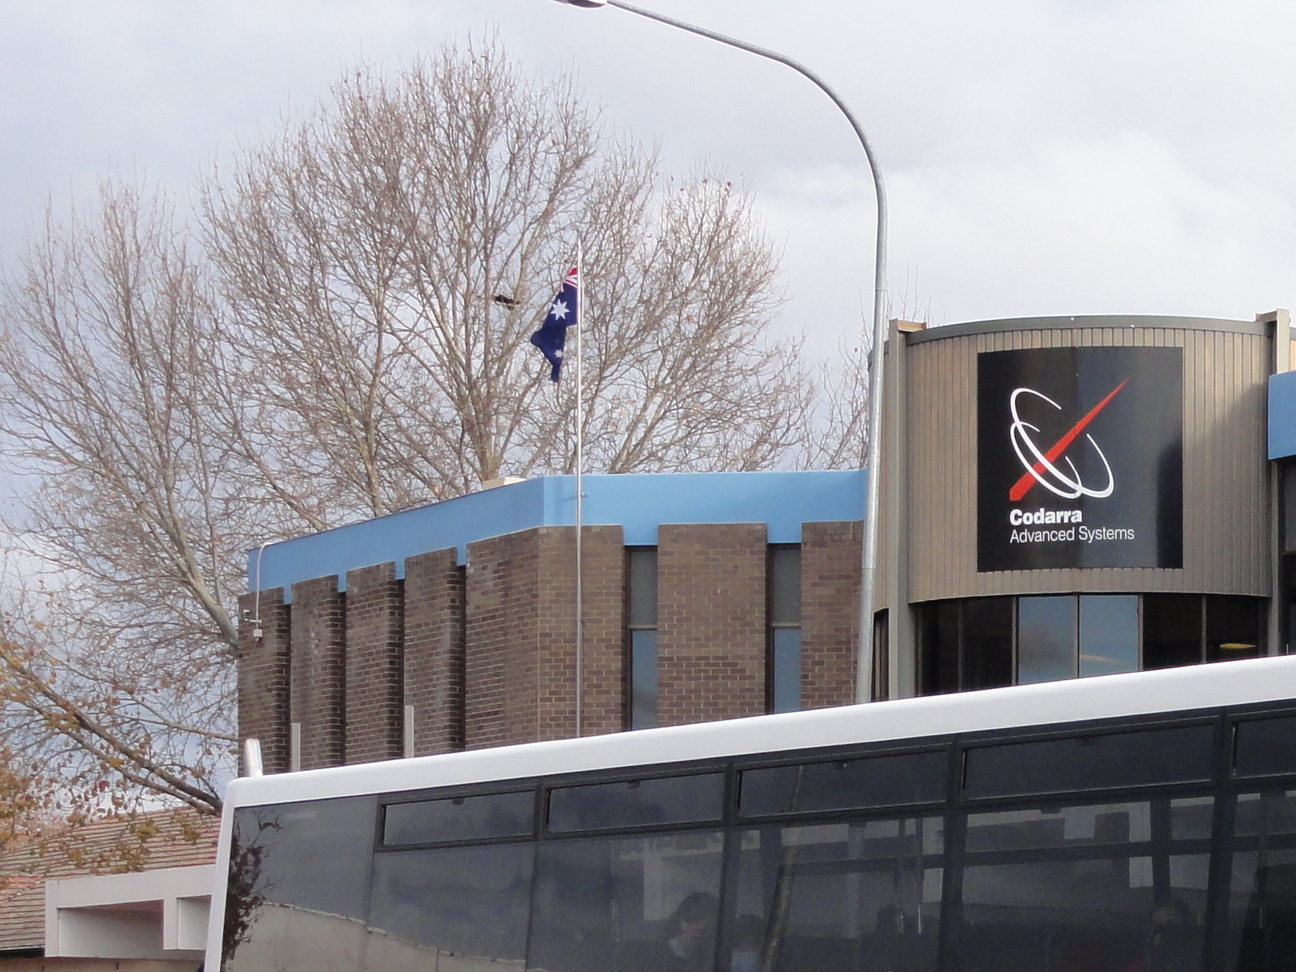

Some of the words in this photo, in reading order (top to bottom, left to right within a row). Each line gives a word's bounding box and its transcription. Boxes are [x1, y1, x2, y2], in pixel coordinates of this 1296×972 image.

[1009, 507, 1083, 526] Codarra
[1009, 527, 1075, 544] Advanced
[1078, 525, 1135, 544] Systems
